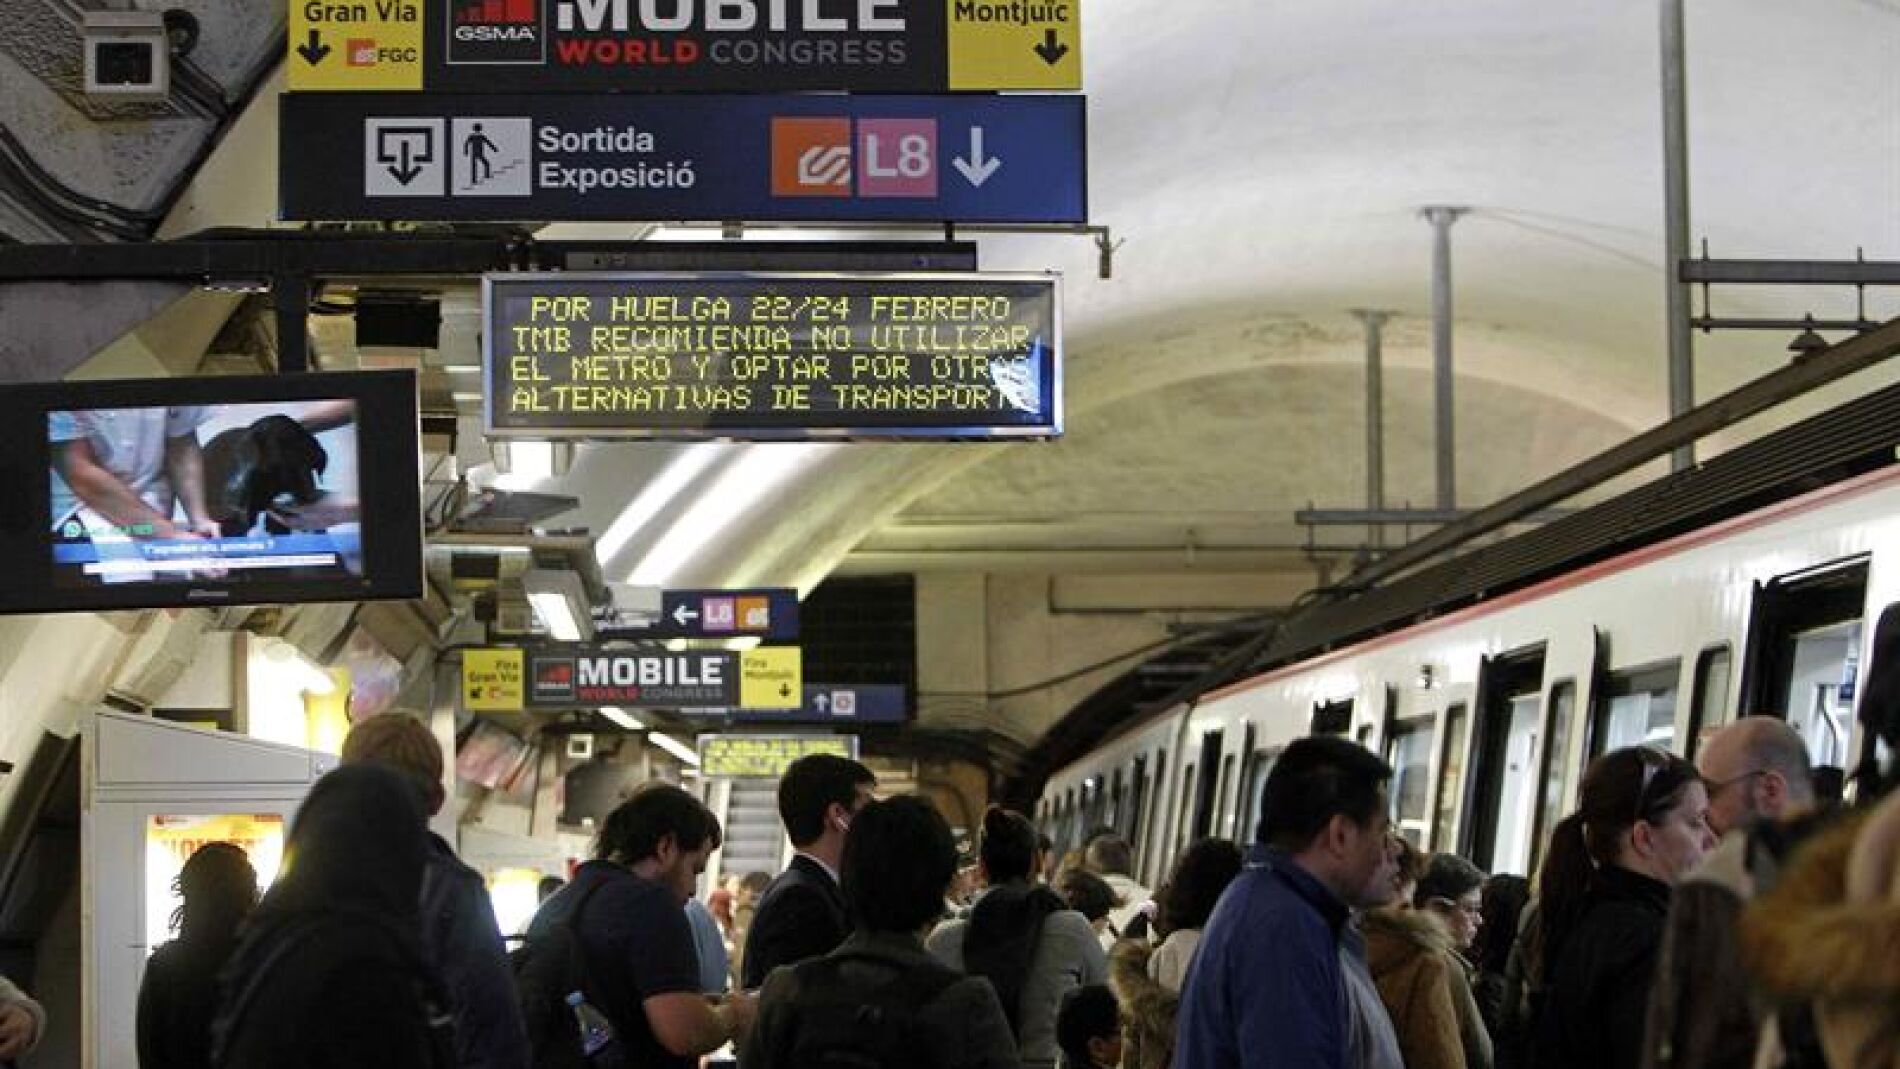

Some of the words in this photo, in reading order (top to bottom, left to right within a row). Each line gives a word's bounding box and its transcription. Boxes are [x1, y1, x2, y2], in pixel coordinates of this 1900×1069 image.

[304, 1, 367, 22] Gran
[375, 0, 417, 22] Via
[456, 25, 535, 41] GSMA
[378, 47, 417, 62] FGC
[556, 39, 699, 65] WORLD
[709, 39, 906, 65] CONGRESS
[538, 126, 654, 153] Sortida
[866, 134, 931, 178] L8
[538, 160, 695, 194] Exposició
[531, 296, 591, 321] POR
[611, 296, 730, 321] HUELGA
[752, 296, 849, 321] 22/24
[871, 296, 1011, 321] FEBRERO
[512, 326, 571, 352] TMB
[591, 325, 791, 352] RECOMIENDA
[811, 325, 851, 351] NO
[871, 324, 1030, 351] UTILIZAR
[511, 355, 551, 381] EL
[571, 355, 671, 381] METRO
[691, 355, 711, 380] Y
[731, 355, 831, 380] OPTAR
[851, 355, 911, 380] POR
[931, 355, 1027, 380] OTR
[511, 385, 751, 411] ALTERNATIVAS
[771, 384, 811, 410] DE
[831, 384, 1021, 410] TRANSPORT
[578, 657, 723, 686] MOBILE
